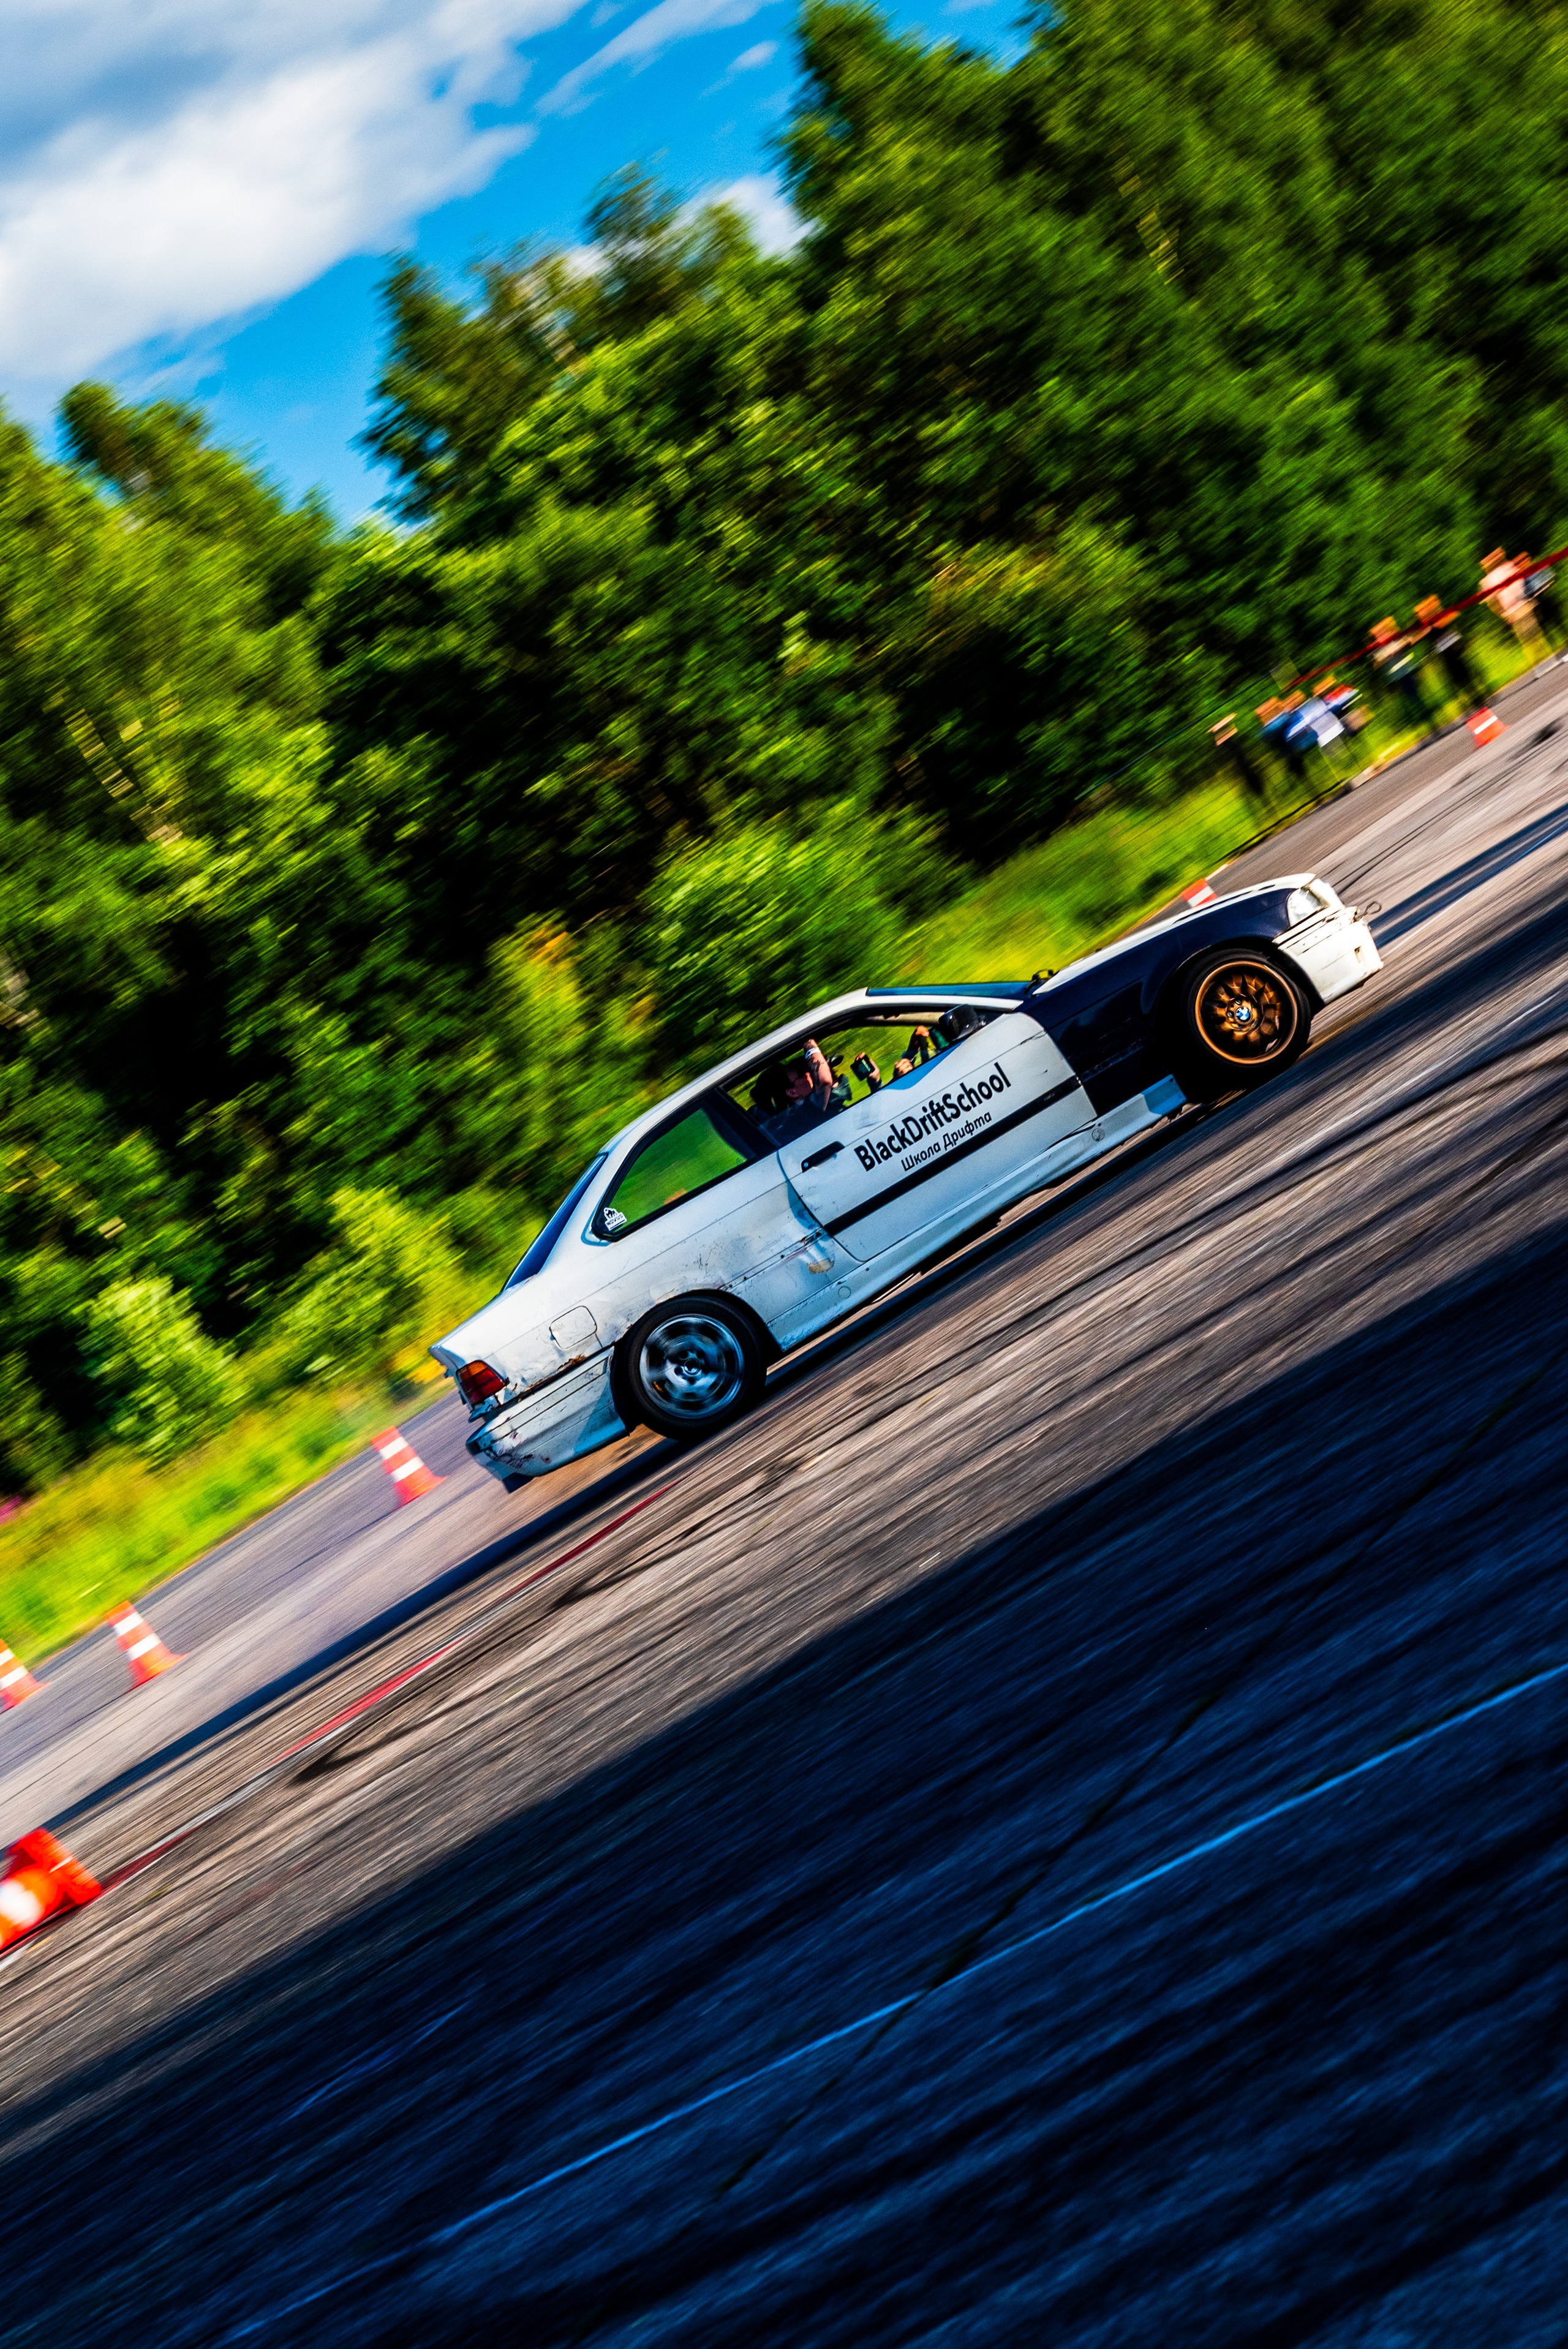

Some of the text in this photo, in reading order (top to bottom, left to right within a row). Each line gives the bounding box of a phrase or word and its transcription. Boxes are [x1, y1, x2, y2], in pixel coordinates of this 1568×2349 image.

[854, 1061, 1012, 1172] BlackDriftSchool
[901, 1111, 992, 1171] Школа Дрифта
